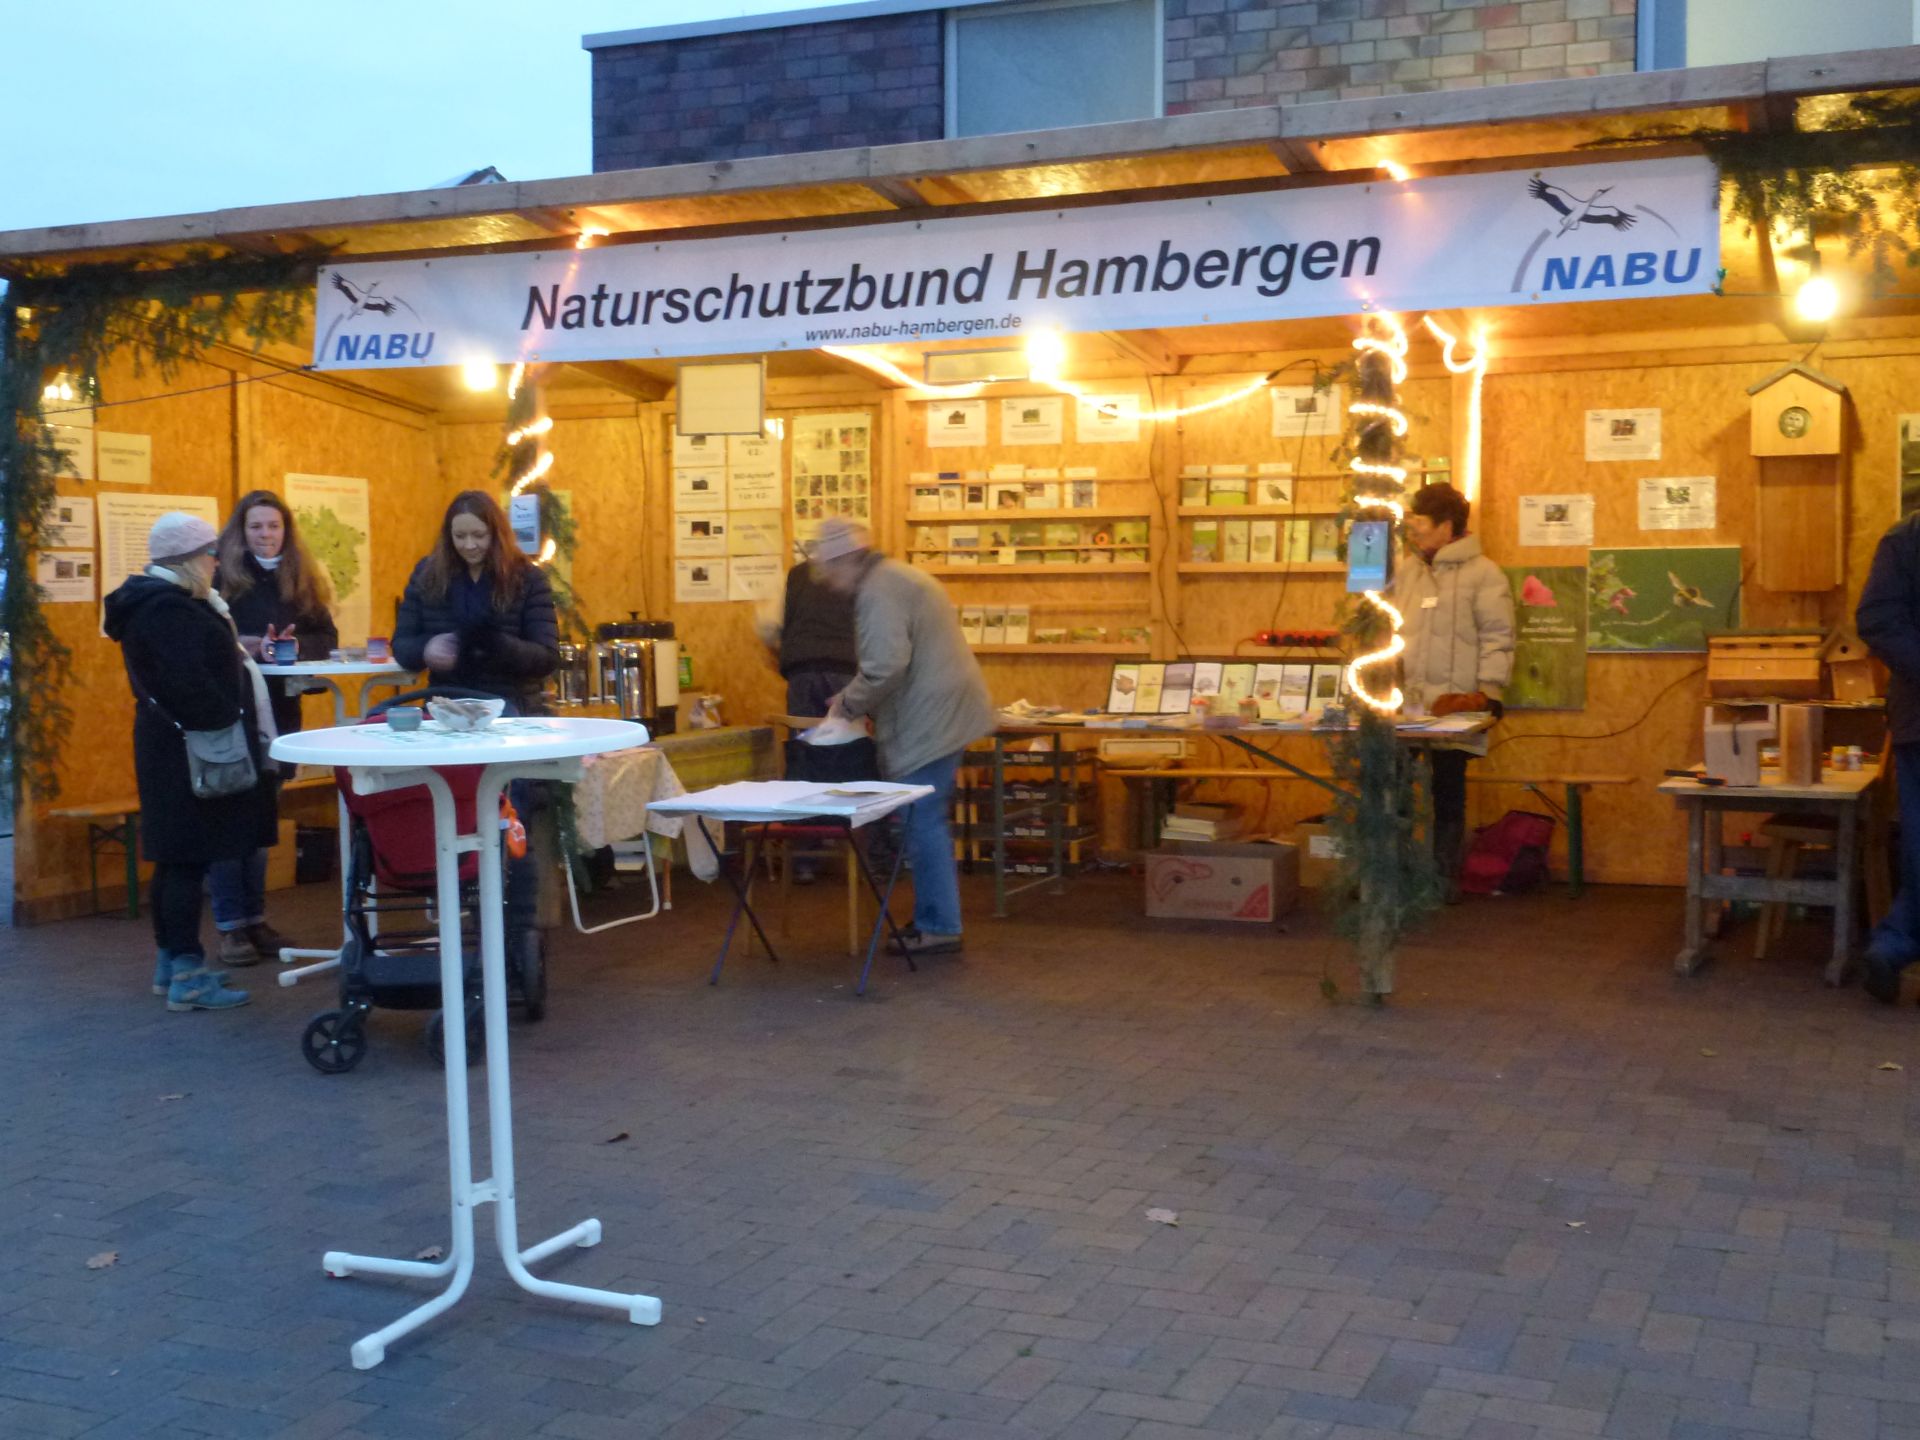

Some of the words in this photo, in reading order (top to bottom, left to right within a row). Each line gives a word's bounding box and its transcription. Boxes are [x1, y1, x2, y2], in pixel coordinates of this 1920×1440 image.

[520, 253, 994, 330] Naturschutzbund
[1007, 235, 1382, 300] Hambergen
[1542, 247, 1702, 291] NABU
[335, 331, 435, 362] NABU
[805, 313, 1022, 343] www.nabu-hambergen.de
